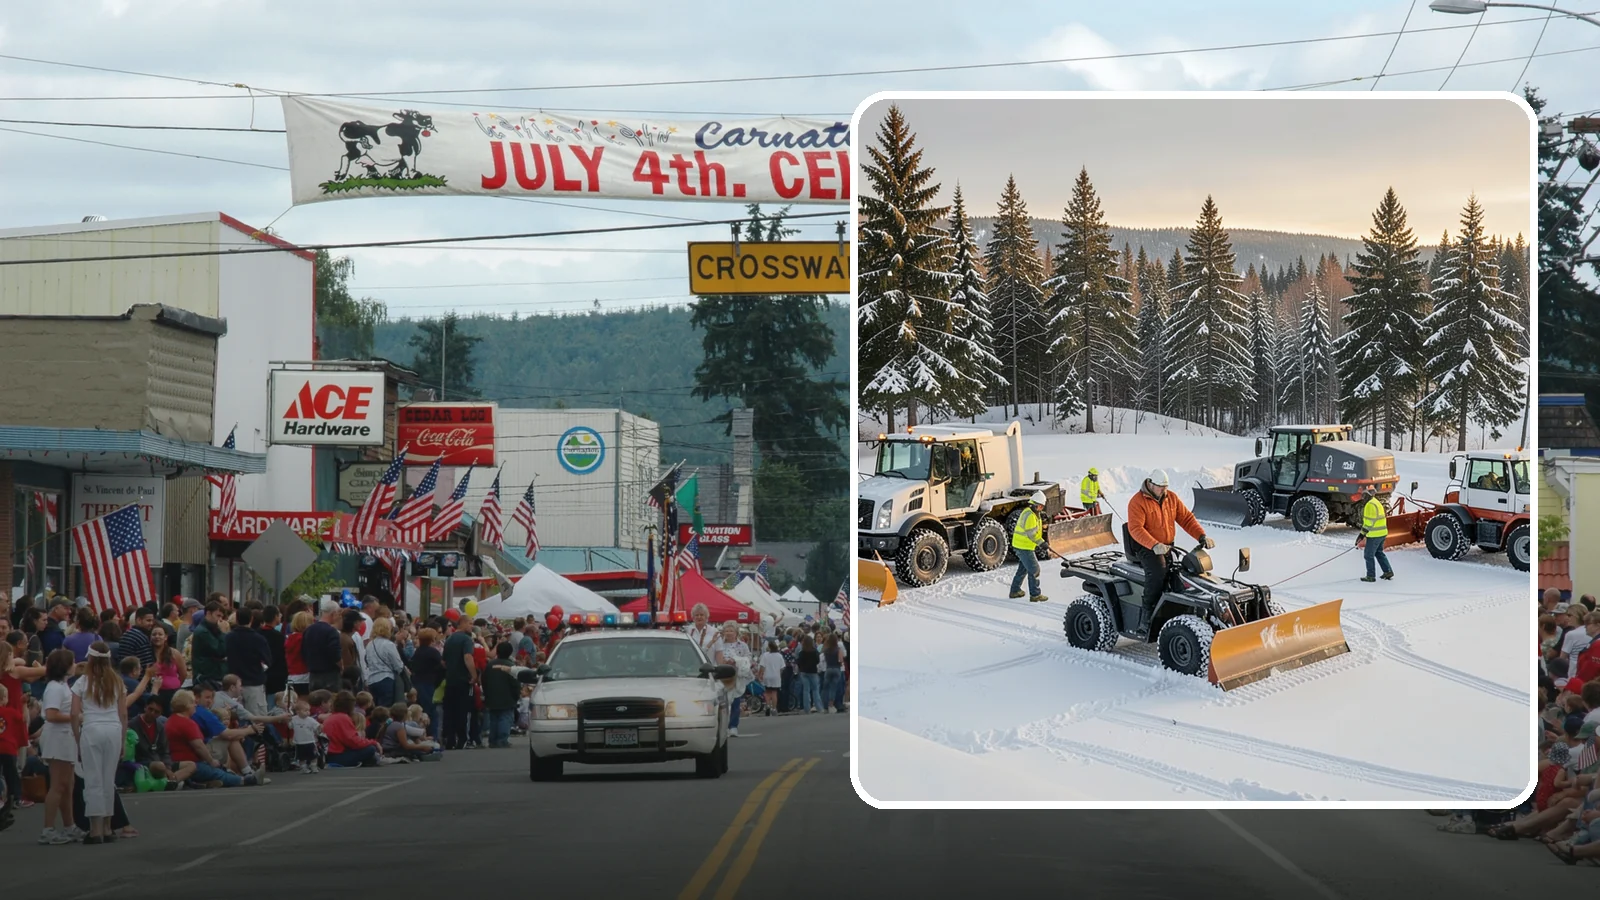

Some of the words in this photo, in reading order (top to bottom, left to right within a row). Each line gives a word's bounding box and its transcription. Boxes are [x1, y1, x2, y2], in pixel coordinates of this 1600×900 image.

[481, 140, 605, 192] JULY
[632, 150, 746, 197] 4th.
[697, 254, 850, 280] CROSSWA
[282, 380, 373, 420] ACE
[405, 409, 453, 422] CEDAR
[283, 420, 371, 436] Hardware
[95, 485, 124, 495] Vincent
[126, 486, 136, 495] de
[137, 486, 155, 495] Paul
[212, 516, 330, 536] HARDARE
[688, 526, 741, 535] CRNATION
